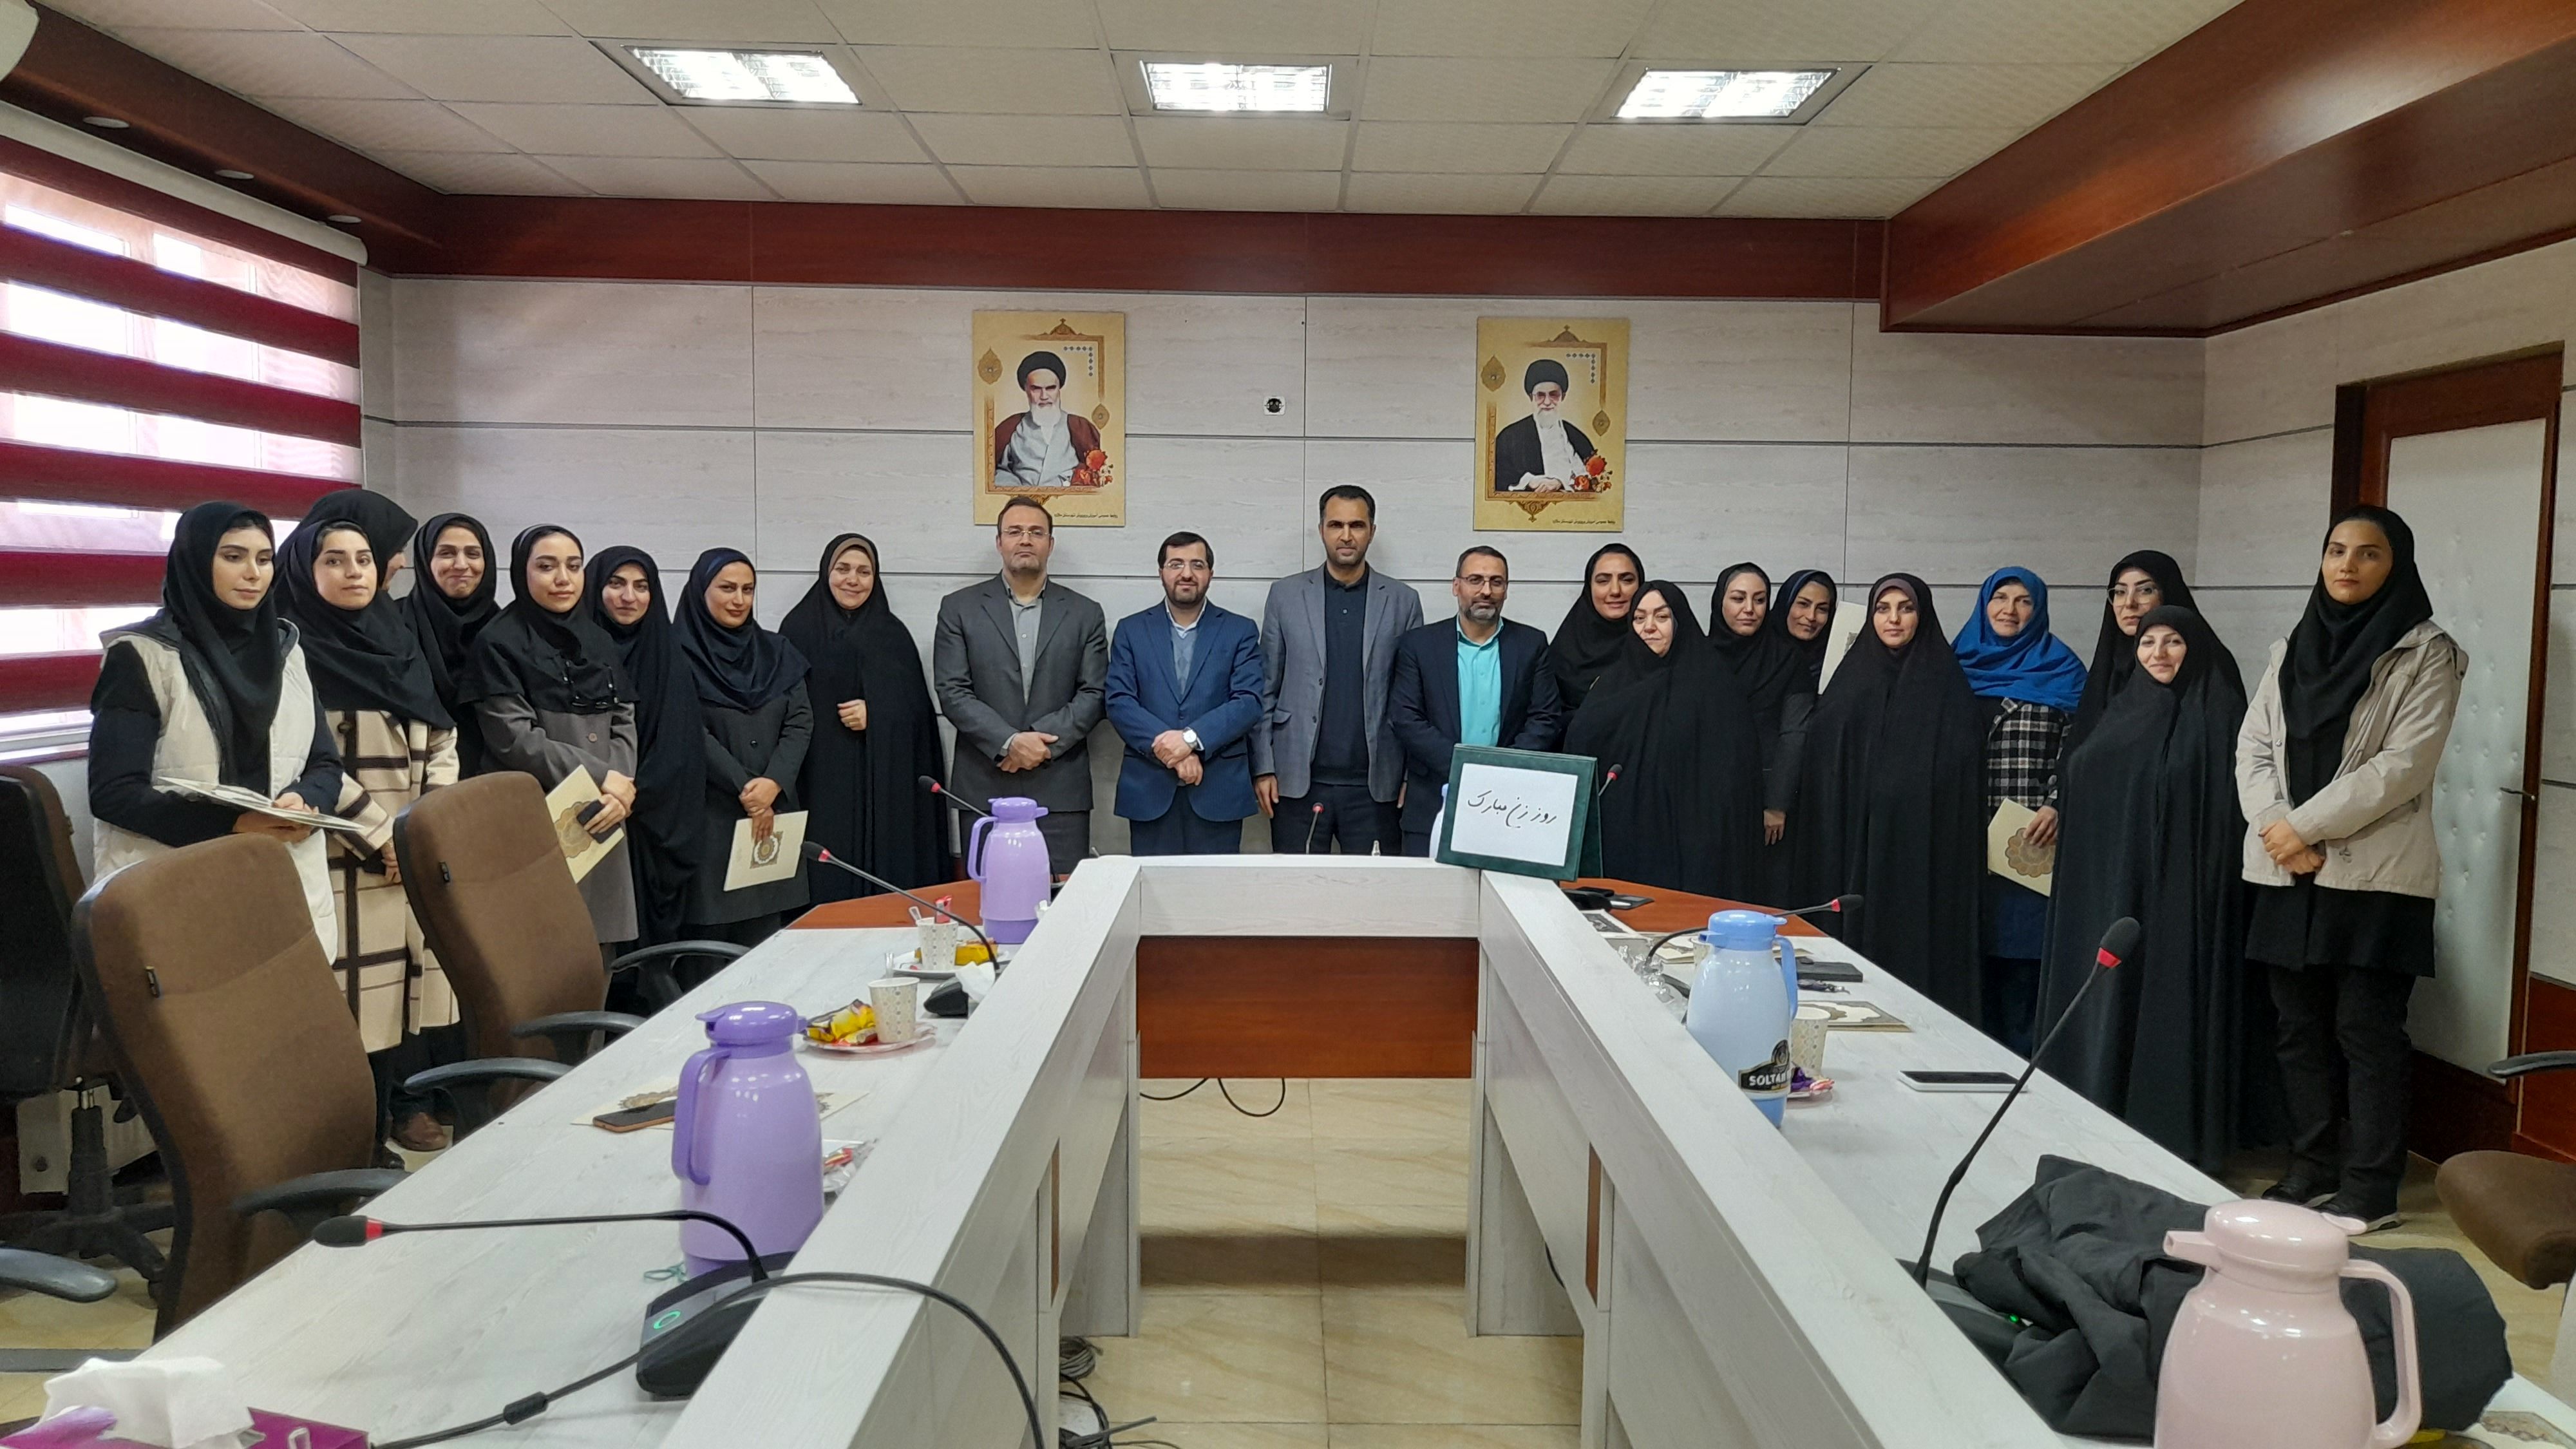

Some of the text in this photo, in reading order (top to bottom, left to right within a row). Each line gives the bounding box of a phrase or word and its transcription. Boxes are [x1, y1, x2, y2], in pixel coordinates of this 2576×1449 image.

[1468, 790, 1557, 828] روز زن مبارک
